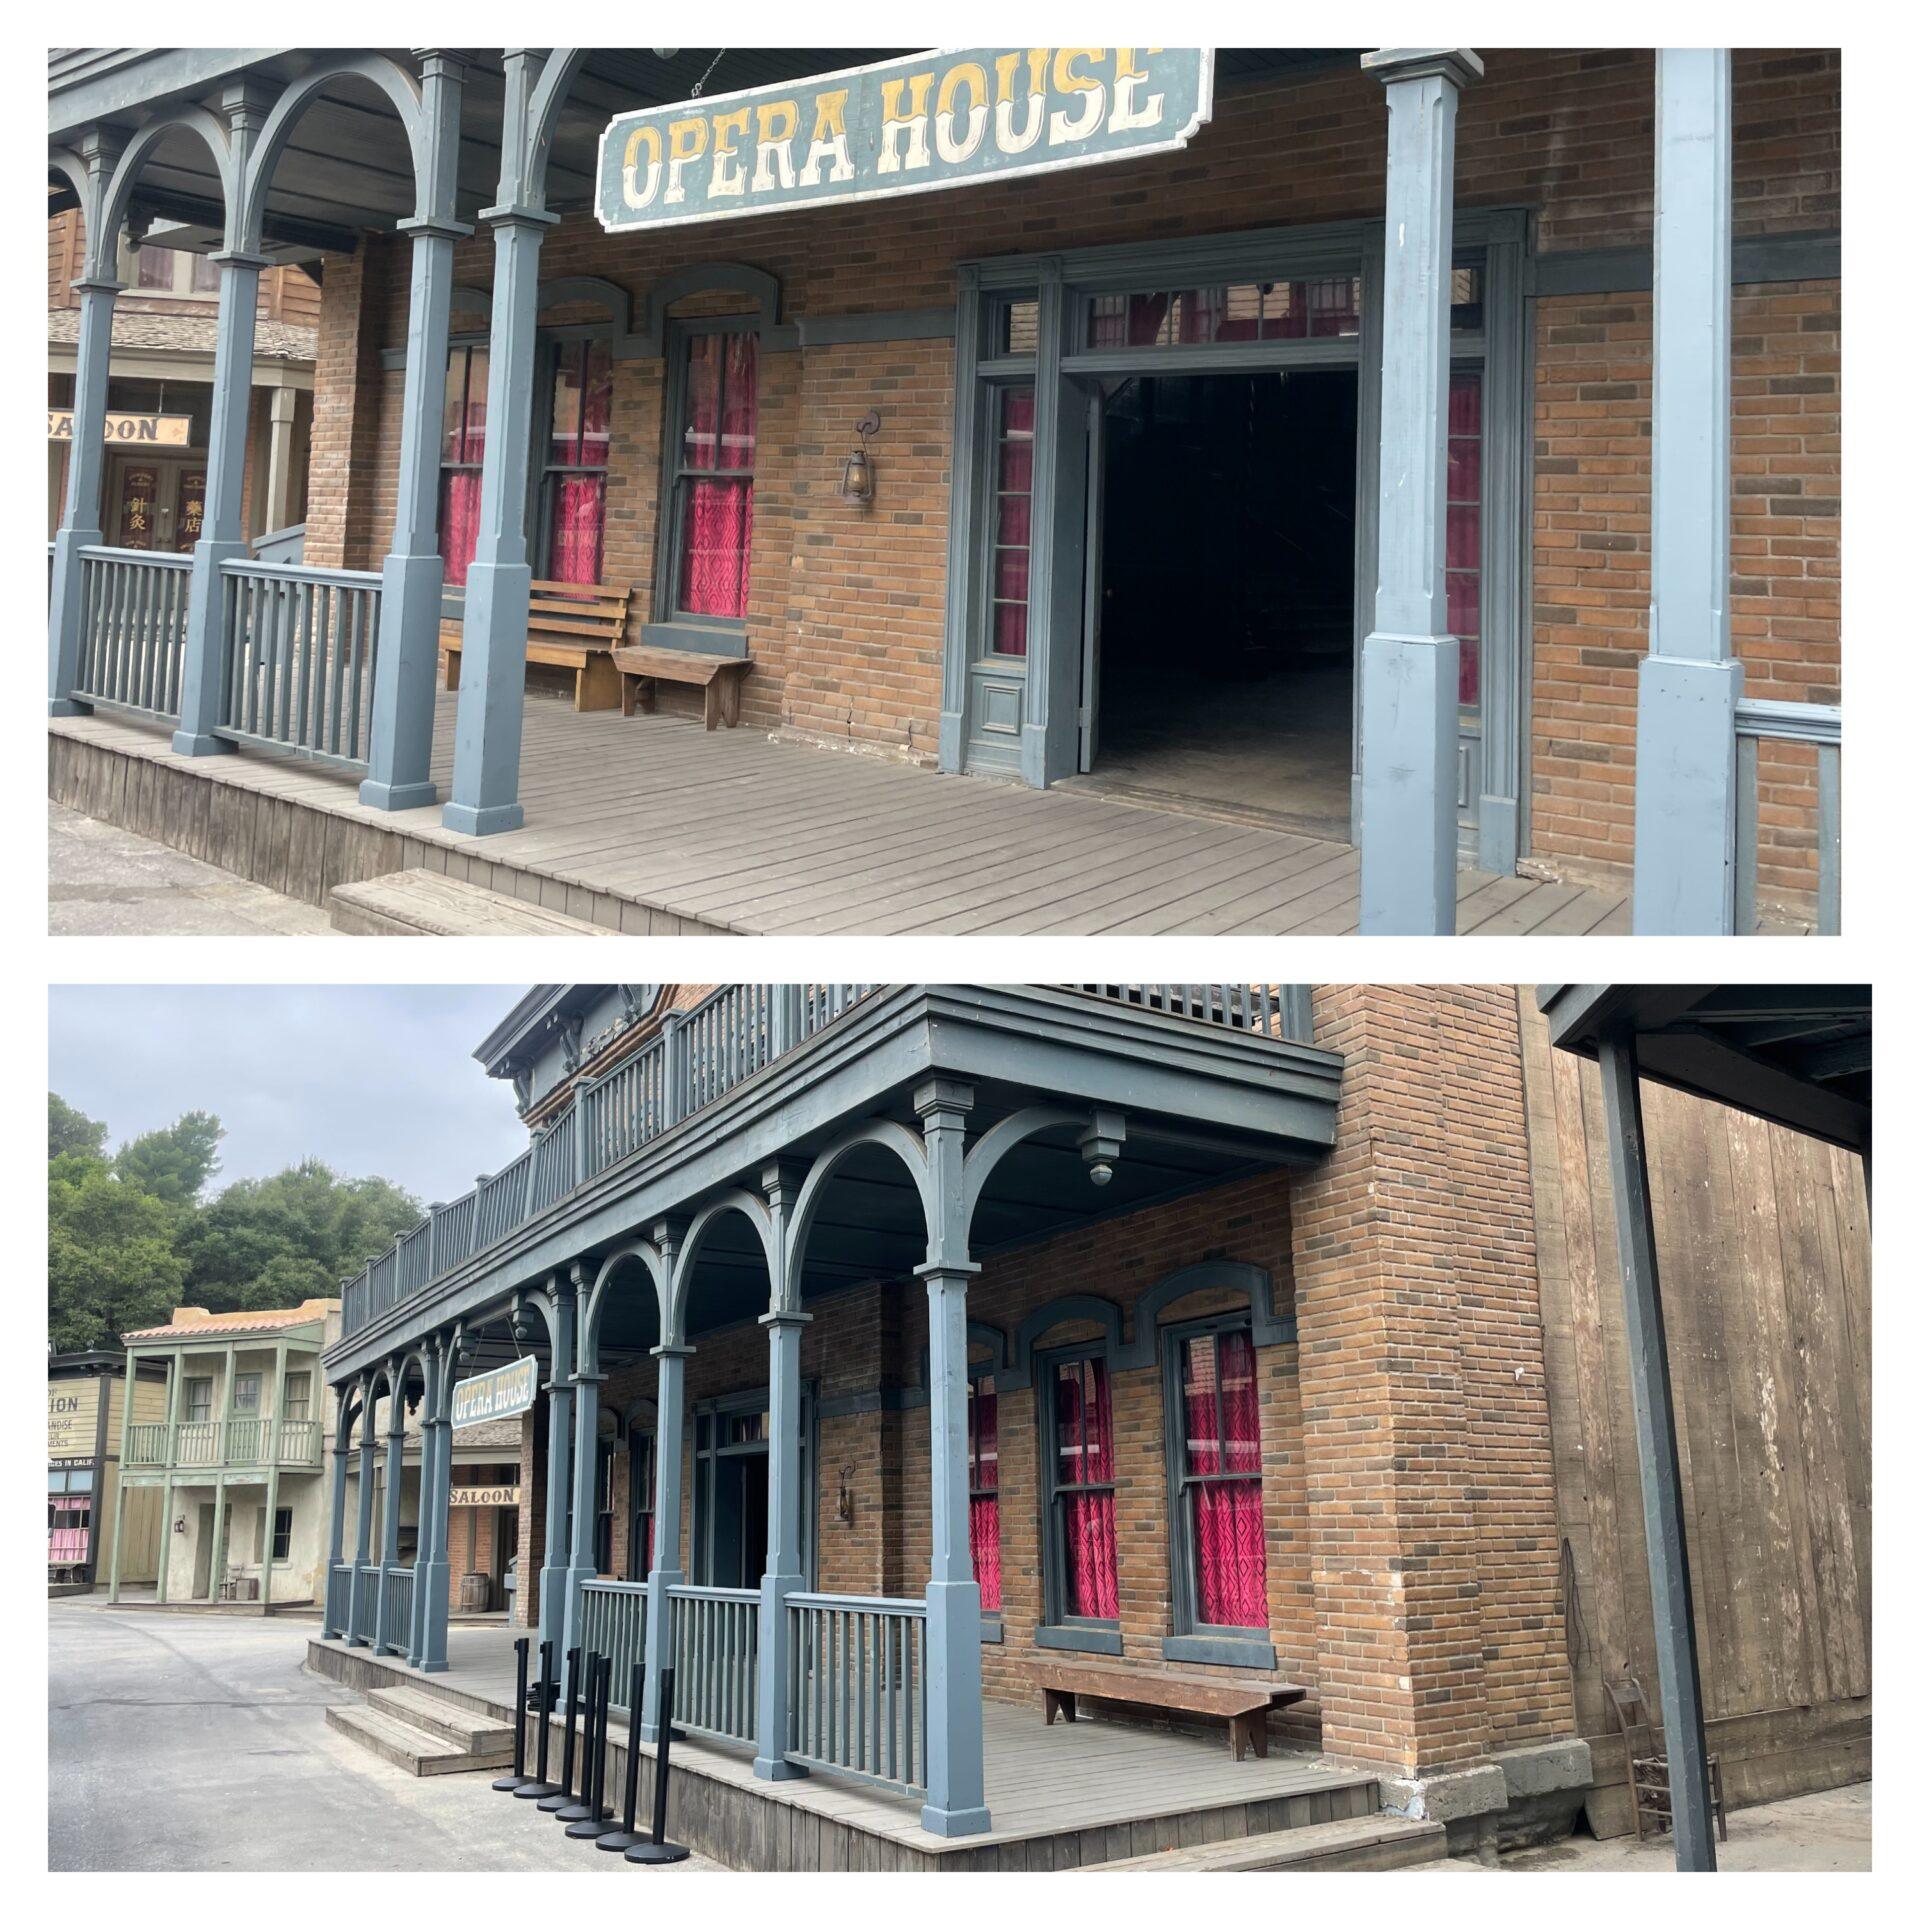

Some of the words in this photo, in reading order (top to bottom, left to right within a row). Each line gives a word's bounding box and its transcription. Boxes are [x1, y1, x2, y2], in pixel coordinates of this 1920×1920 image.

[622, 88, 856, 210] OPERA
[877, 48, 1165, 175] HOUSE
[456, 1380, 493, 1421] OPERA
[495, 1365, 530, 1411] HOUSE
[450, 1488, 514, 1504] SALOON
